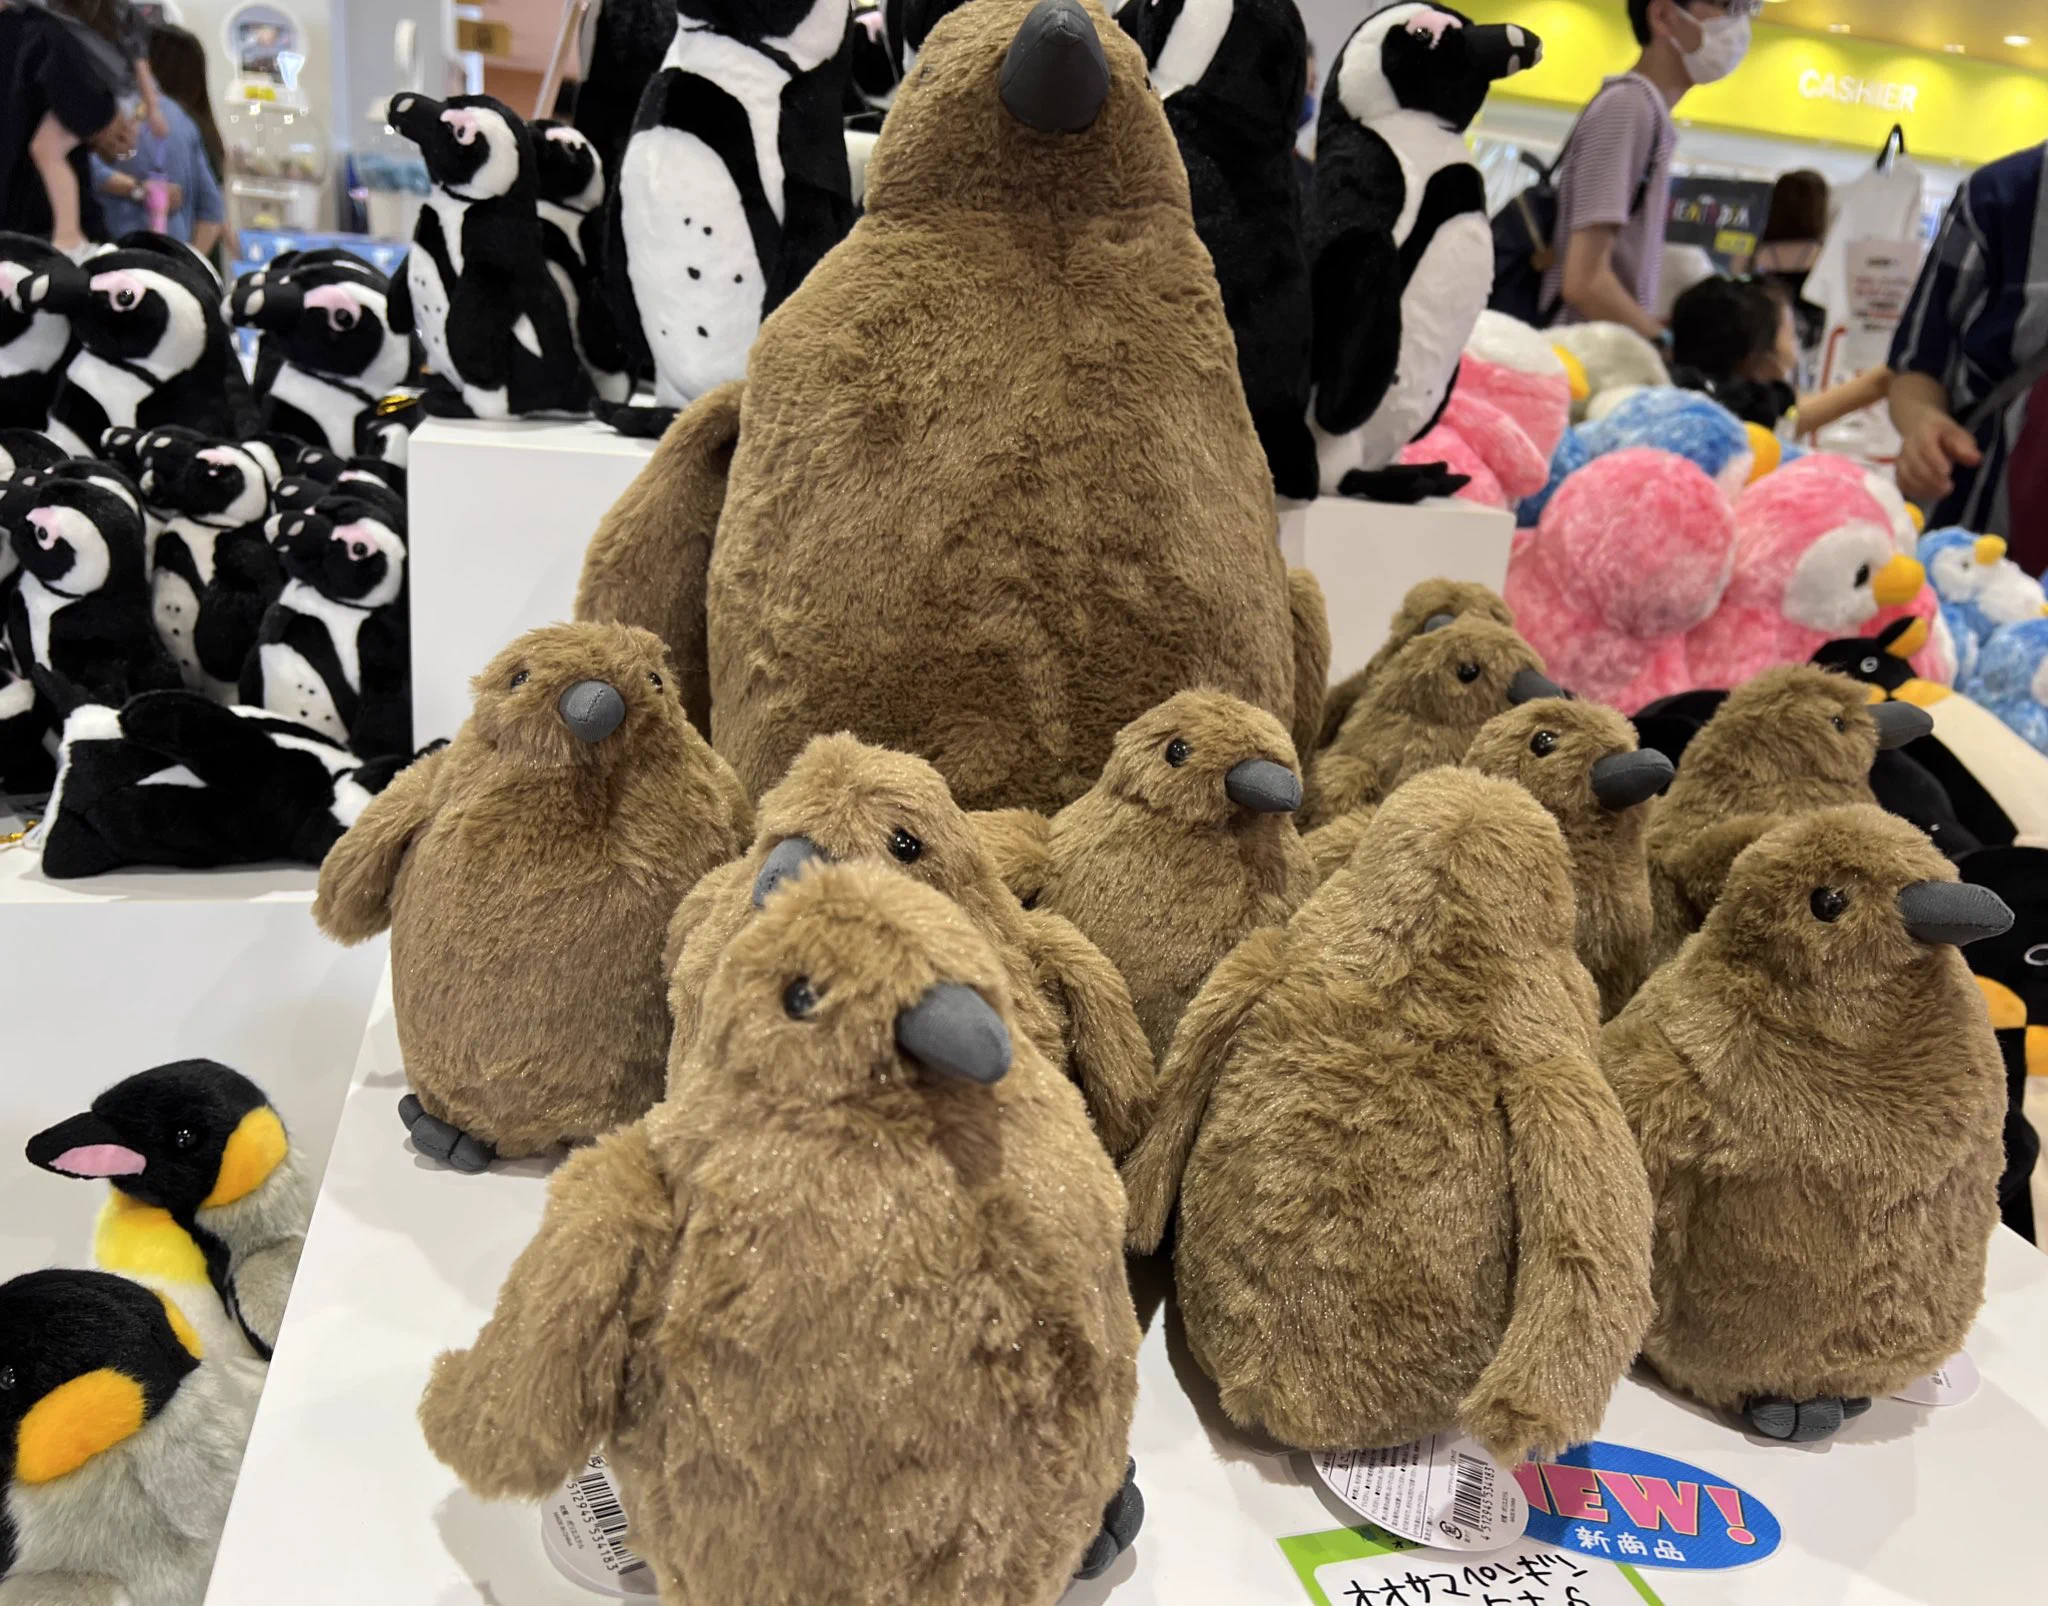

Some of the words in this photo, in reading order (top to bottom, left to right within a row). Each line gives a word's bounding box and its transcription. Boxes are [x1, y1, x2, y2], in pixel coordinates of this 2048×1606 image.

[1798, 69, 1918, 112] CASHIER
[566, 1482, 595, 1523] 512945
[589, 1528, 619, 1571] 534183
[1575, 1526, 1686, 1562] 新商品
